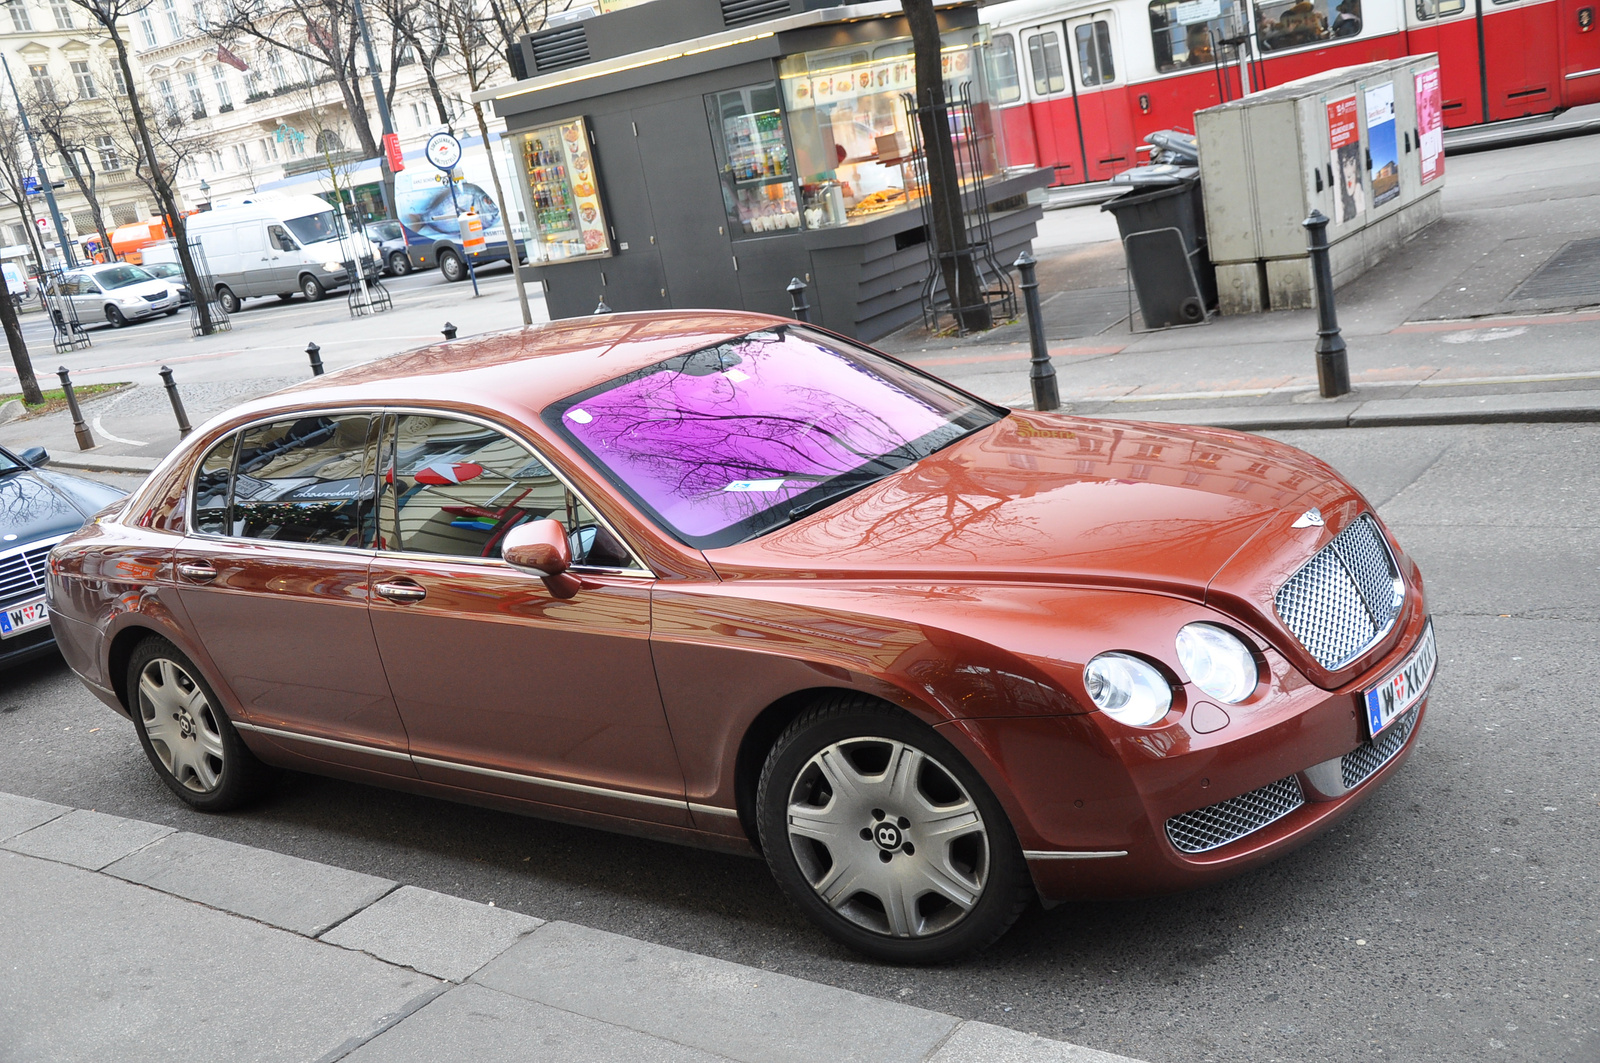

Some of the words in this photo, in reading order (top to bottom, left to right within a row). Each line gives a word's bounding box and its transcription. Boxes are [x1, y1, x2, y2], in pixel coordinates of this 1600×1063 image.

[11, 609, 24, 627] W
[35, 603, 48, 619] 2
[1373, 715, 1380, 726] A
[1382, 682, 1394, 716] W
